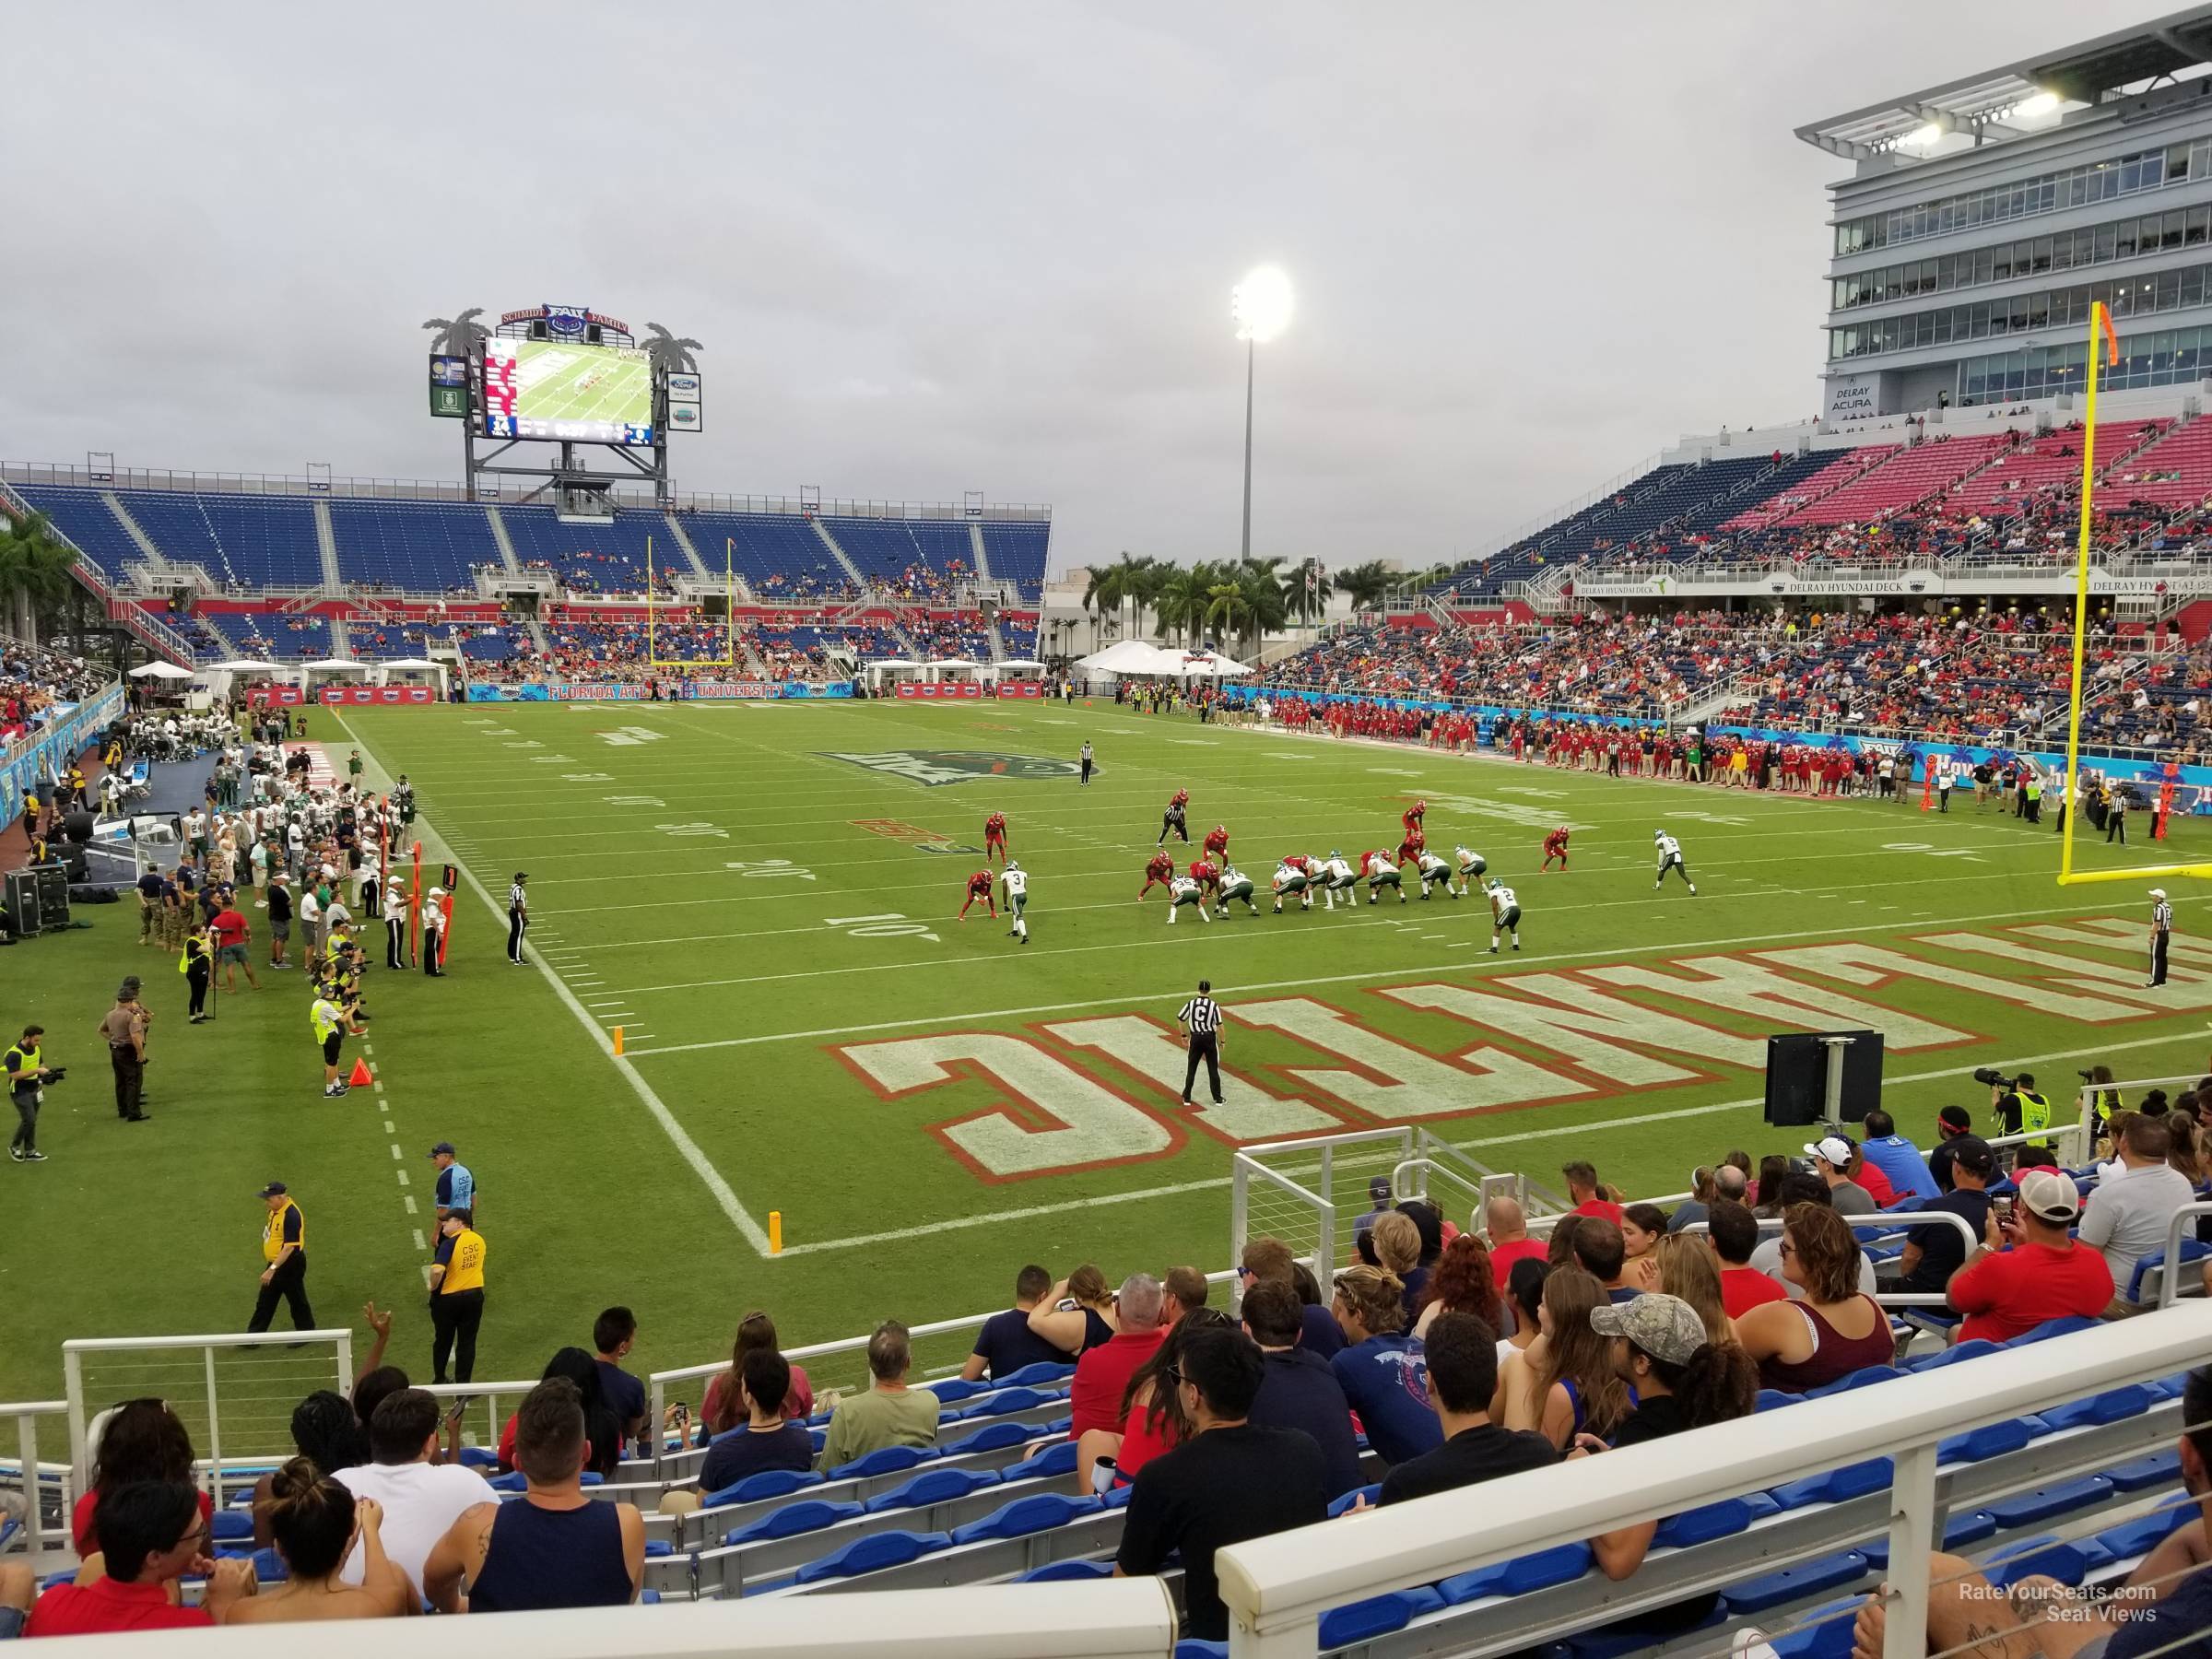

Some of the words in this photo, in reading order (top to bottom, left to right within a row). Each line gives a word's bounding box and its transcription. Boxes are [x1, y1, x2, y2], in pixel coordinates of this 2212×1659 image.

[502, 309, 545, 323] SCHMIDT
[549, 306, 585, 319] FAU
[592, 312, 628, 332] FAMILY
[1837, 387, 1870, 398] DELRAY
[1831, 398, 1872, 411] ACURA
[1790, 582, 1826, 593] DELRAY
[1828, 582, 1874, 593] HYUNDAI
[1876, 582, 1903, 592] DECK
[2093, 581, 2137, 591] DELRAY
[548, 687, 614, 700] FLORIDA
[697, 685, 782, 699] UNIVERSITY
[191, 824, 203, 833] 24
[722, 858, 811, 877] 20
[448, 868, 454, 887] 1
[1012, 874, 1021, 885] 3
[1176, 879, 1194, 888] 35
[1503, 890, 1513, 901] 2
[823, 912, 930, 936] 10
[1194, 1006, 1206, 1021] C
[463, 1243, 479, 1255] CSC
[463, 1253, 479, 1264] EVENT
